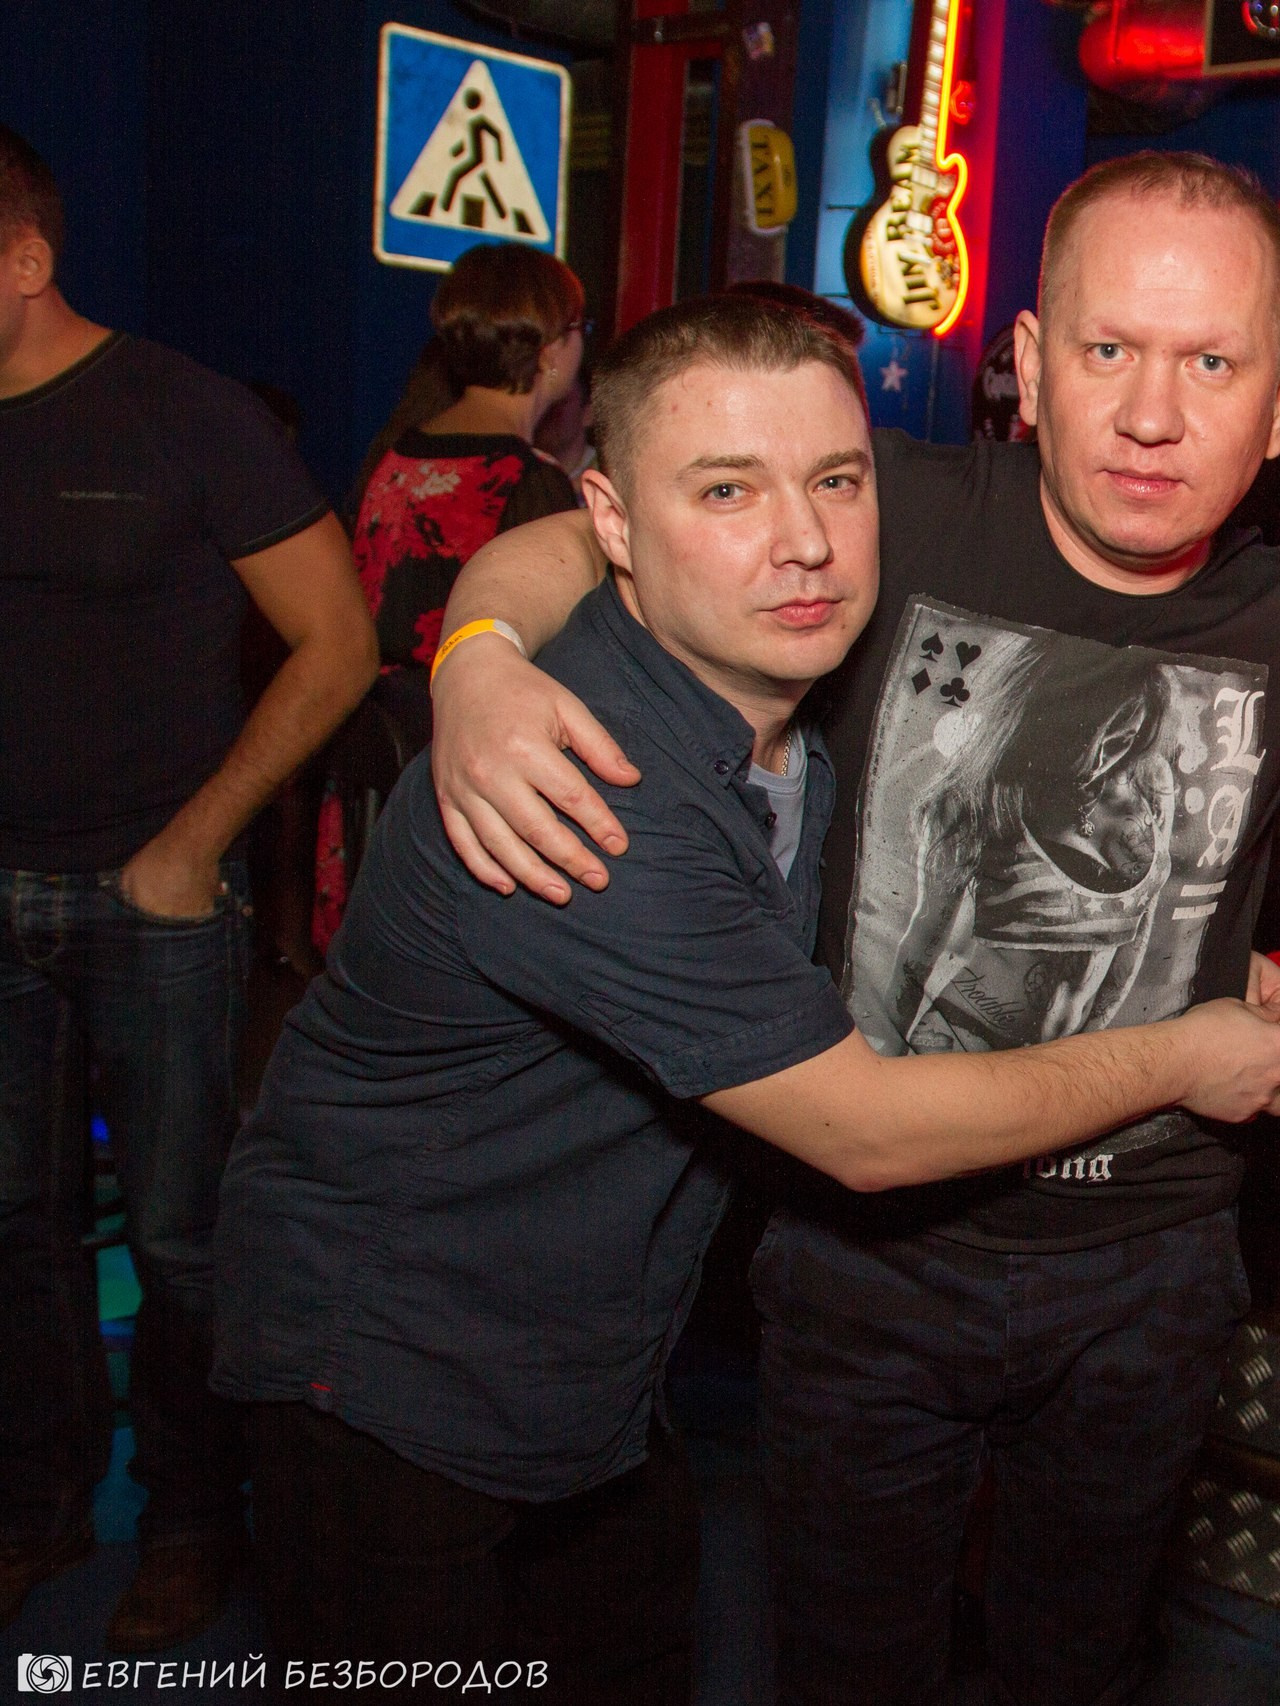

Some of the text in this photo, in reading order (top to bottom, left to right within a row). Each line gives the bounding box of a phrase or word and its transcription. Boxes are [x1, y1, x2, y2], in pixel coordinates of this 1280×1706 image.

[750, 133, 774, 215] TAXI
[886, 144, 940, 310] JIM BEAM
